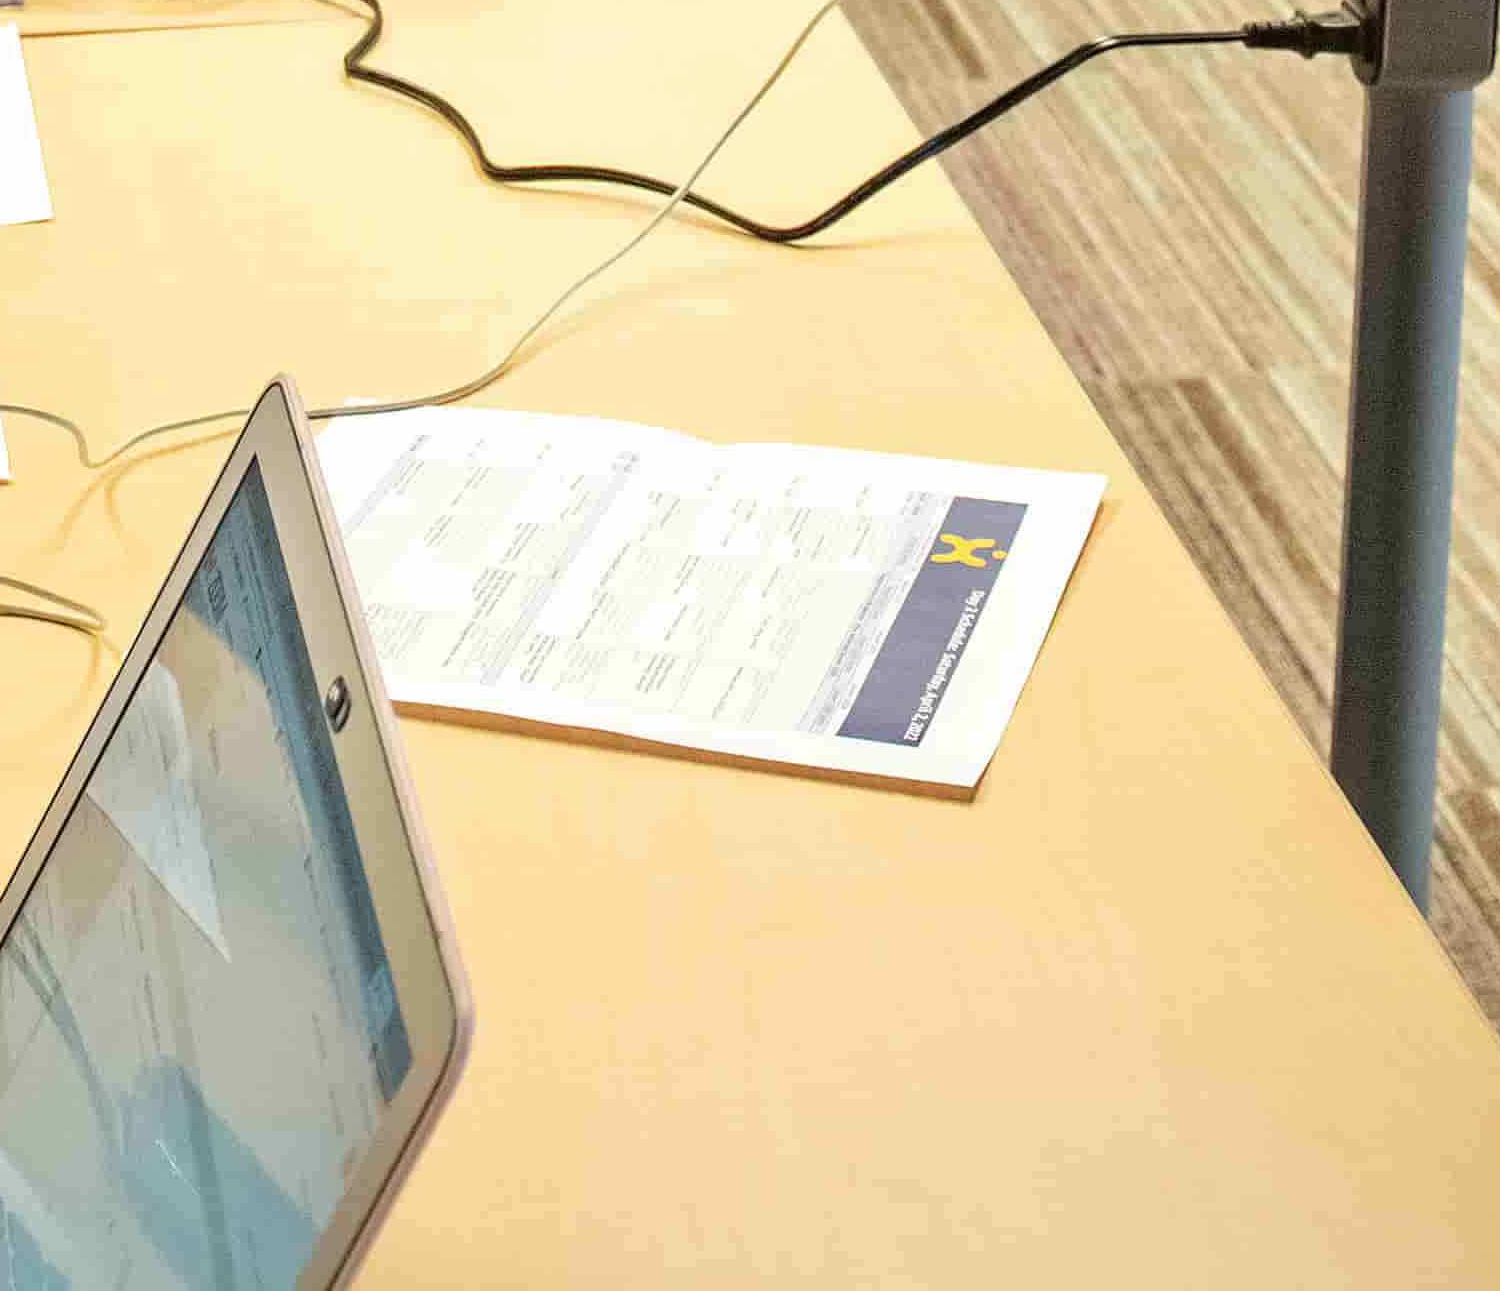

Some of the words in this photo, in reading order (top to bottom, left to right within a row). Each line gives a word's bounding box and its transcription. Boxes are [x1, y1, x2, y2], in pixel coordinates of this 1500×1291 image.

[963, 589, 985, 607] Day
[915, 689, 940, 713] April
[902, 721, 925, 741] 2022
